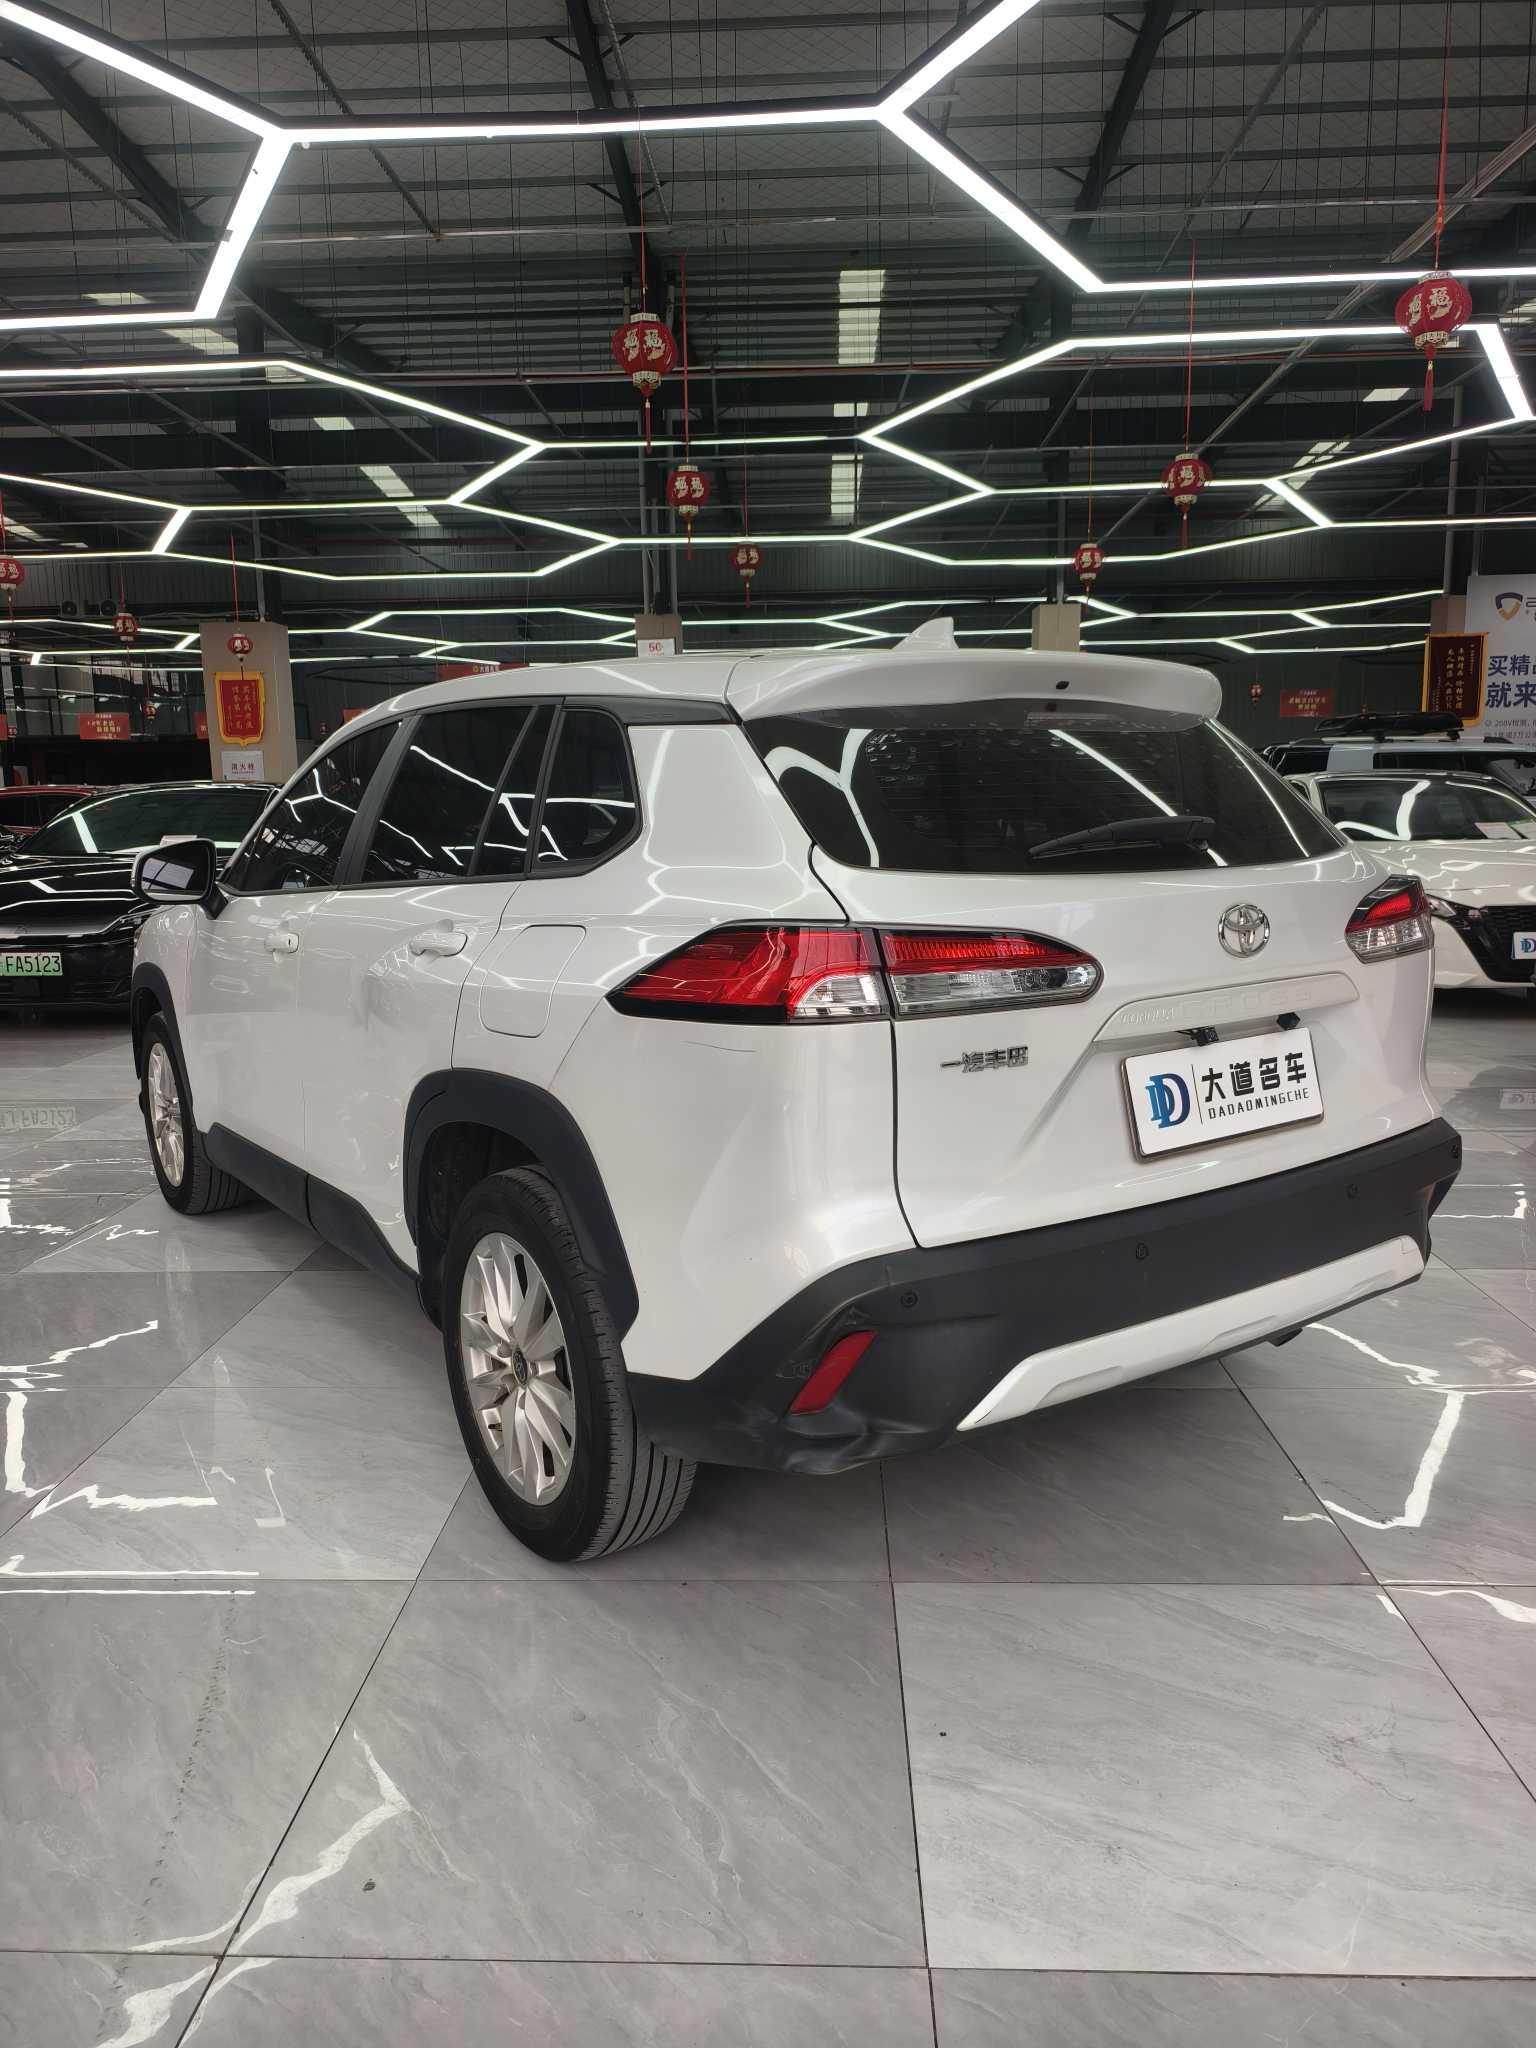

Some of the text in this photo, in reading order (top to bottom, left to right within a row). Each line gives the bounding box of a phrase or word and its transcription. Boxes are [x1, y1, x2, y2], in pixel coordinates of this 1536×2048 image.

[1487, 654, 1536, 677] 买精
[1485, 681, 1536, 709] 就来
[5, 955, 61, 973] FA5123
[1201, 1052, 1307, 1102] 大道名车
[1207, 1087, 1310, 1120] DADAOMINGCHE
